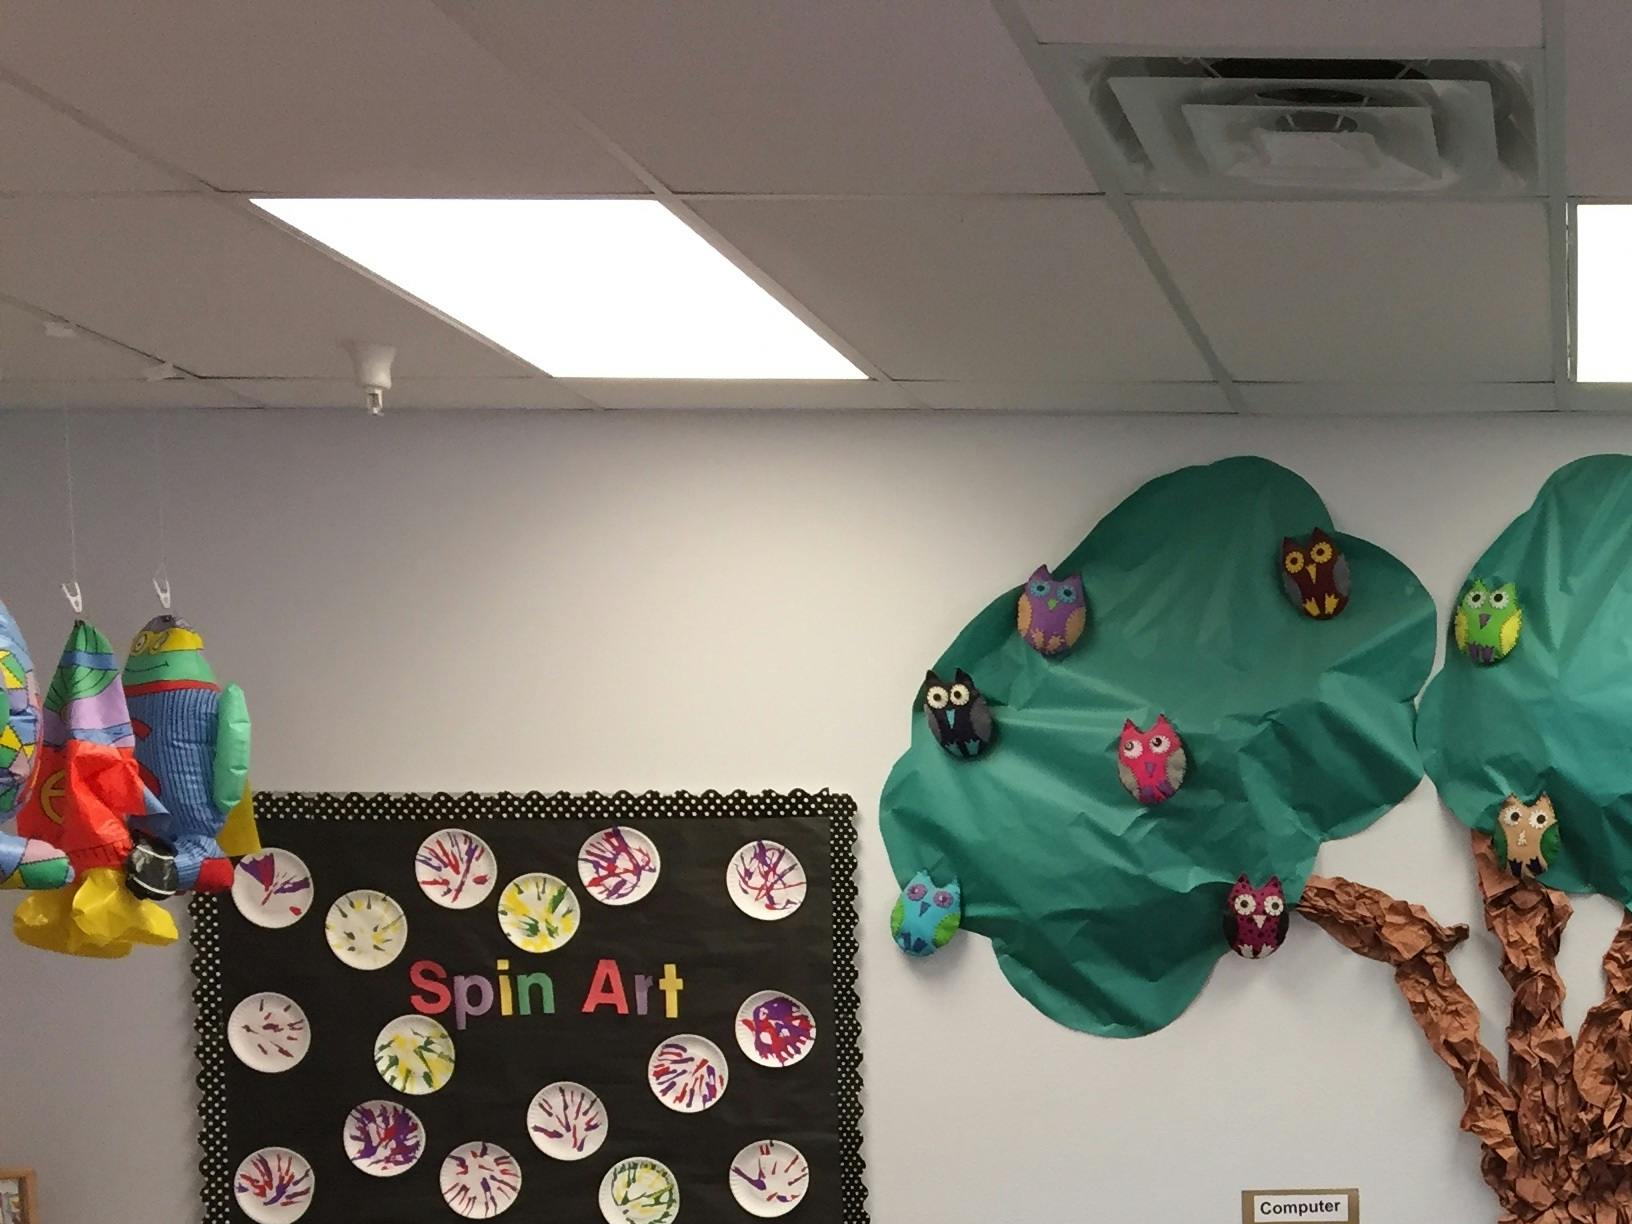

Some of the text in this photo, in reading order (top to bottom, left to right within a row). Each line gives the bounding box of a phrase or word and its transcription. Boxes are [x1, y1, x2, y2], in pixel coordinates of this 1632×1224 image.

[409, 958, 684, 1031] Spin Art
[1260, 1200, 1341, 1216] Computer
